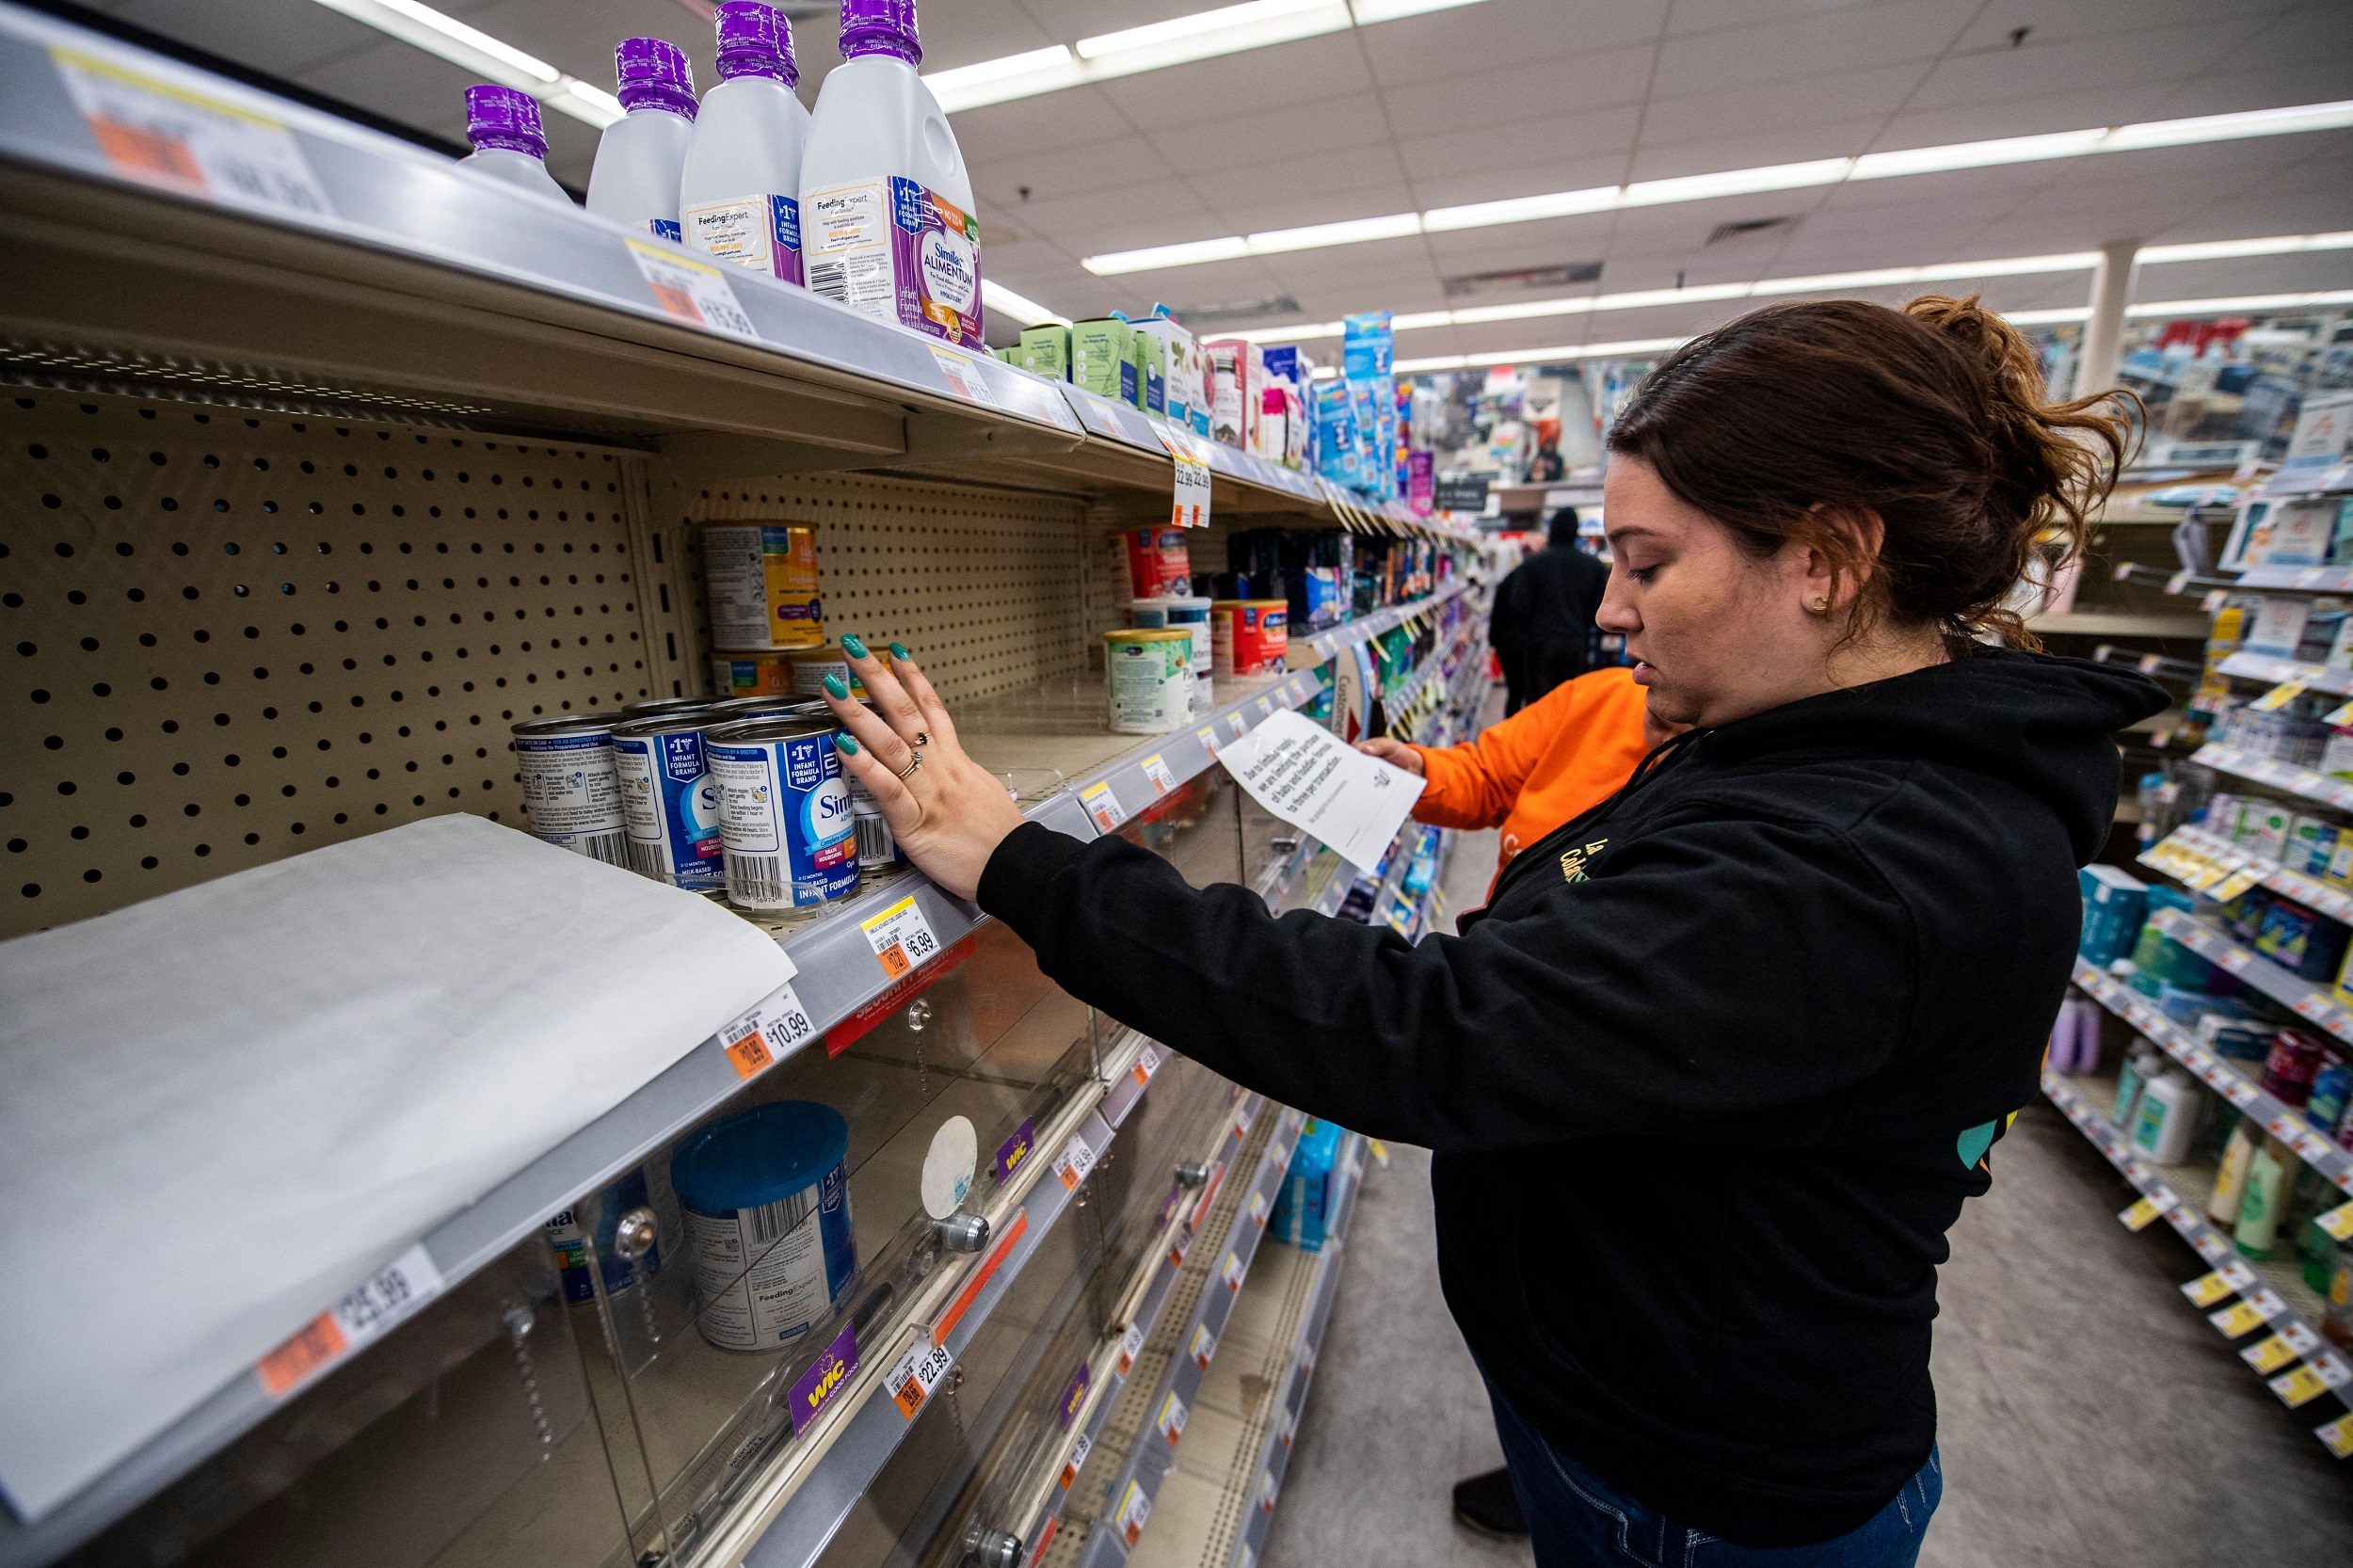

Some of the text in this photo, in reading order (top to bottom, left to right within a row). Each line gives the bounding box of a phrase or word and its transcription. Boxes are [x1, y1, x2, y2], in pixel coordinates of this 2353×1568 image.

[817, 195, 867, 210] Feedingxpert
[698, 212, 748, 226] FeedingExpert
[924, 254, 973, 287] ALIMENTUM
[1176, 470, 1193, 487] 22.99
[1194, 472, 1209, 488] 22.99
[672, 754, 695, 762] INFANT
[793, 761, 816, 770] INFANT
[675, 767, 696, 776] BRAND
[791, 769, 820, 778] FORMULA
[1257, 782, 1269, 792] we
[1265, 776, 1276, 786] are
[1272, 759, 1296, 777] limiting
[1289, 750, 1302, 760] the
[1296, 757, 1318, 776] toddler
[796, 776, 817, 784] BRAND
[1287, 757, 1341, 813] to three per transaction.
[1289, 774, 1300, 786] and
[1272, 792, 1280, 803] of
[1275, 784, 1294, 798] baby
[818, 851, 843, 863] NOURISHING
[829, 874, 855, 890] FORMULA
[906, 933, 933, 957] $6.99
[766, 1013, 808, 1047] $10.99
[767, 1018, 780, 1027] RETAIL
[1006, 1141, 1027, 1170] WIC
[759, 1275, 818, 1302] FeedingExpert
[919, 1348, 947, 1384] $22.99
[808, 1359, 844, 1407] WIC
[829, 1379, 843, 1397] GOOD
[844, 1363, 859, 1379] FOOD
